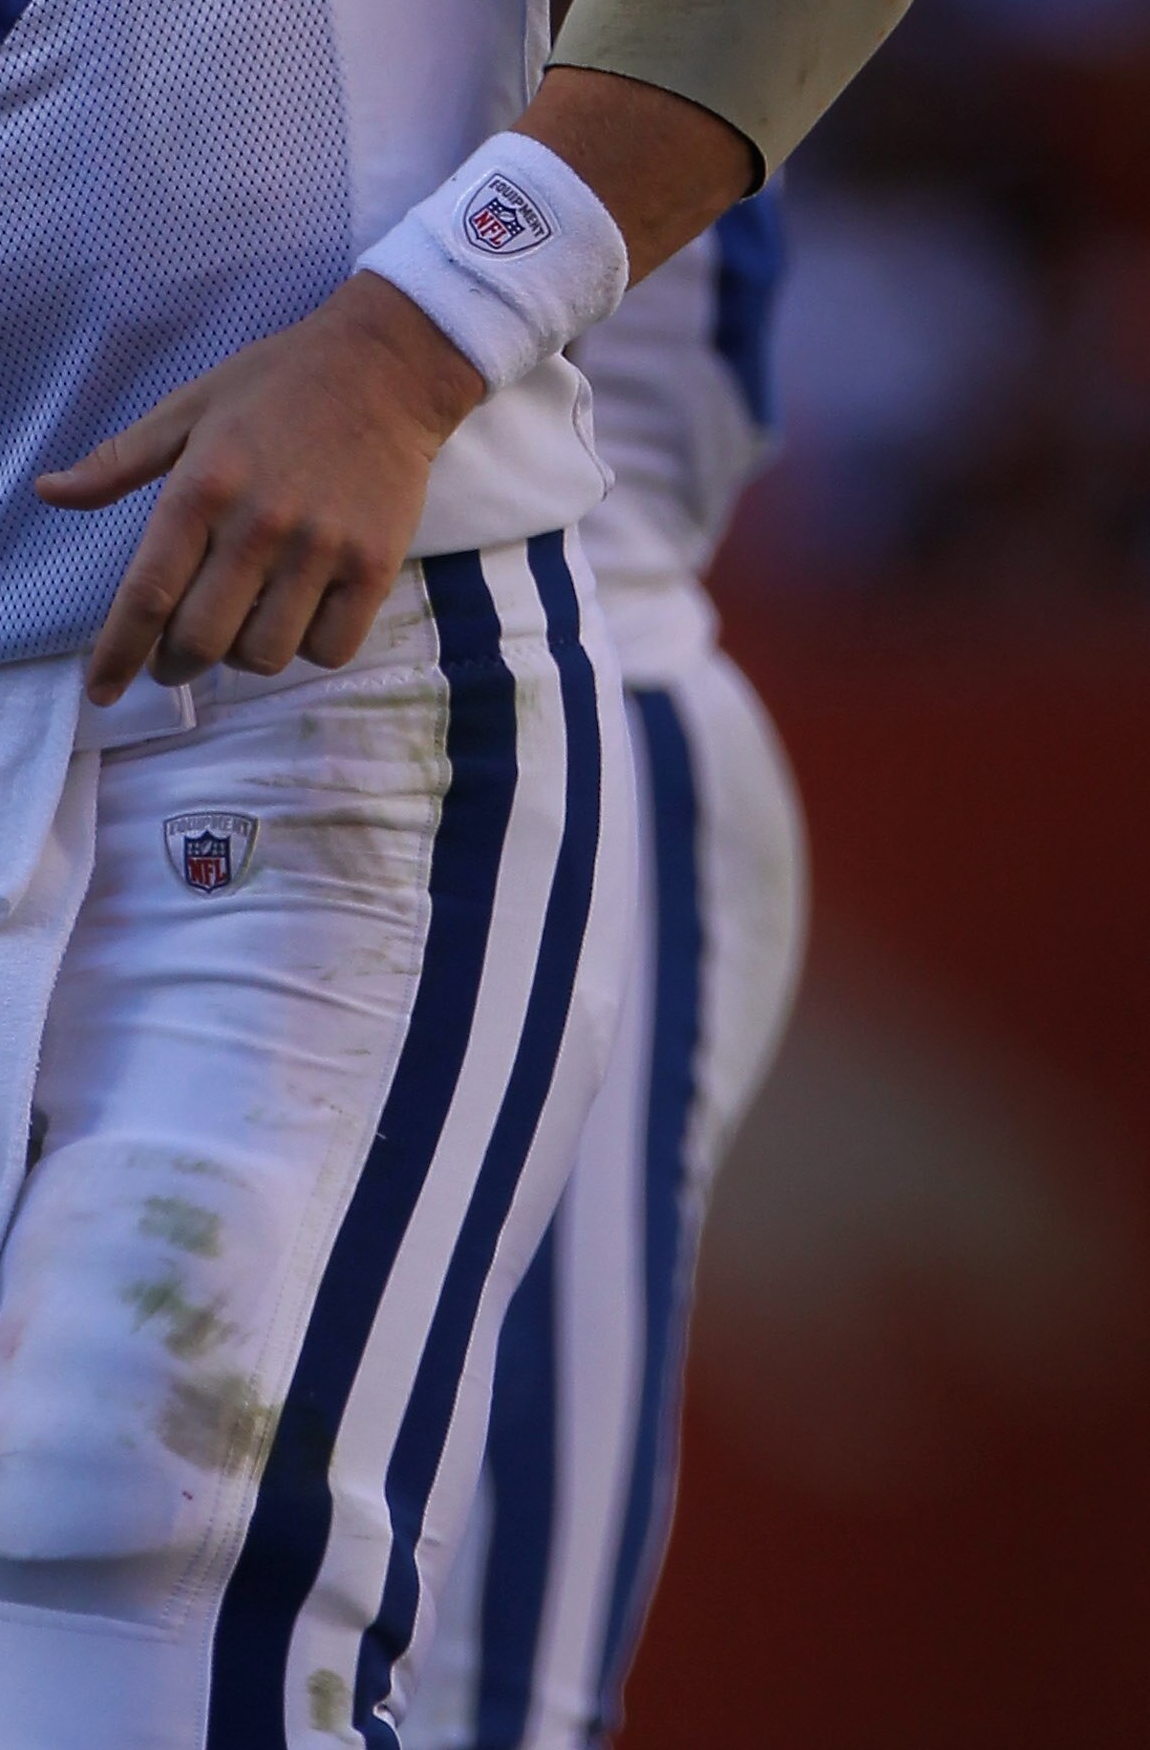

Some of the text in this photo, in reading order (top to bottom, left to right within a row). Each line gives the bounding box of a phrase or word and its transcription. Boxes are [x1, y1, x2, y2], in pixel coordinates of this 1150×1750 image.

[488, 179, 545, 238] EQUIPMENT
[472, 210, 507, 245] NFL
[187, 858, 228, 885] NFL
